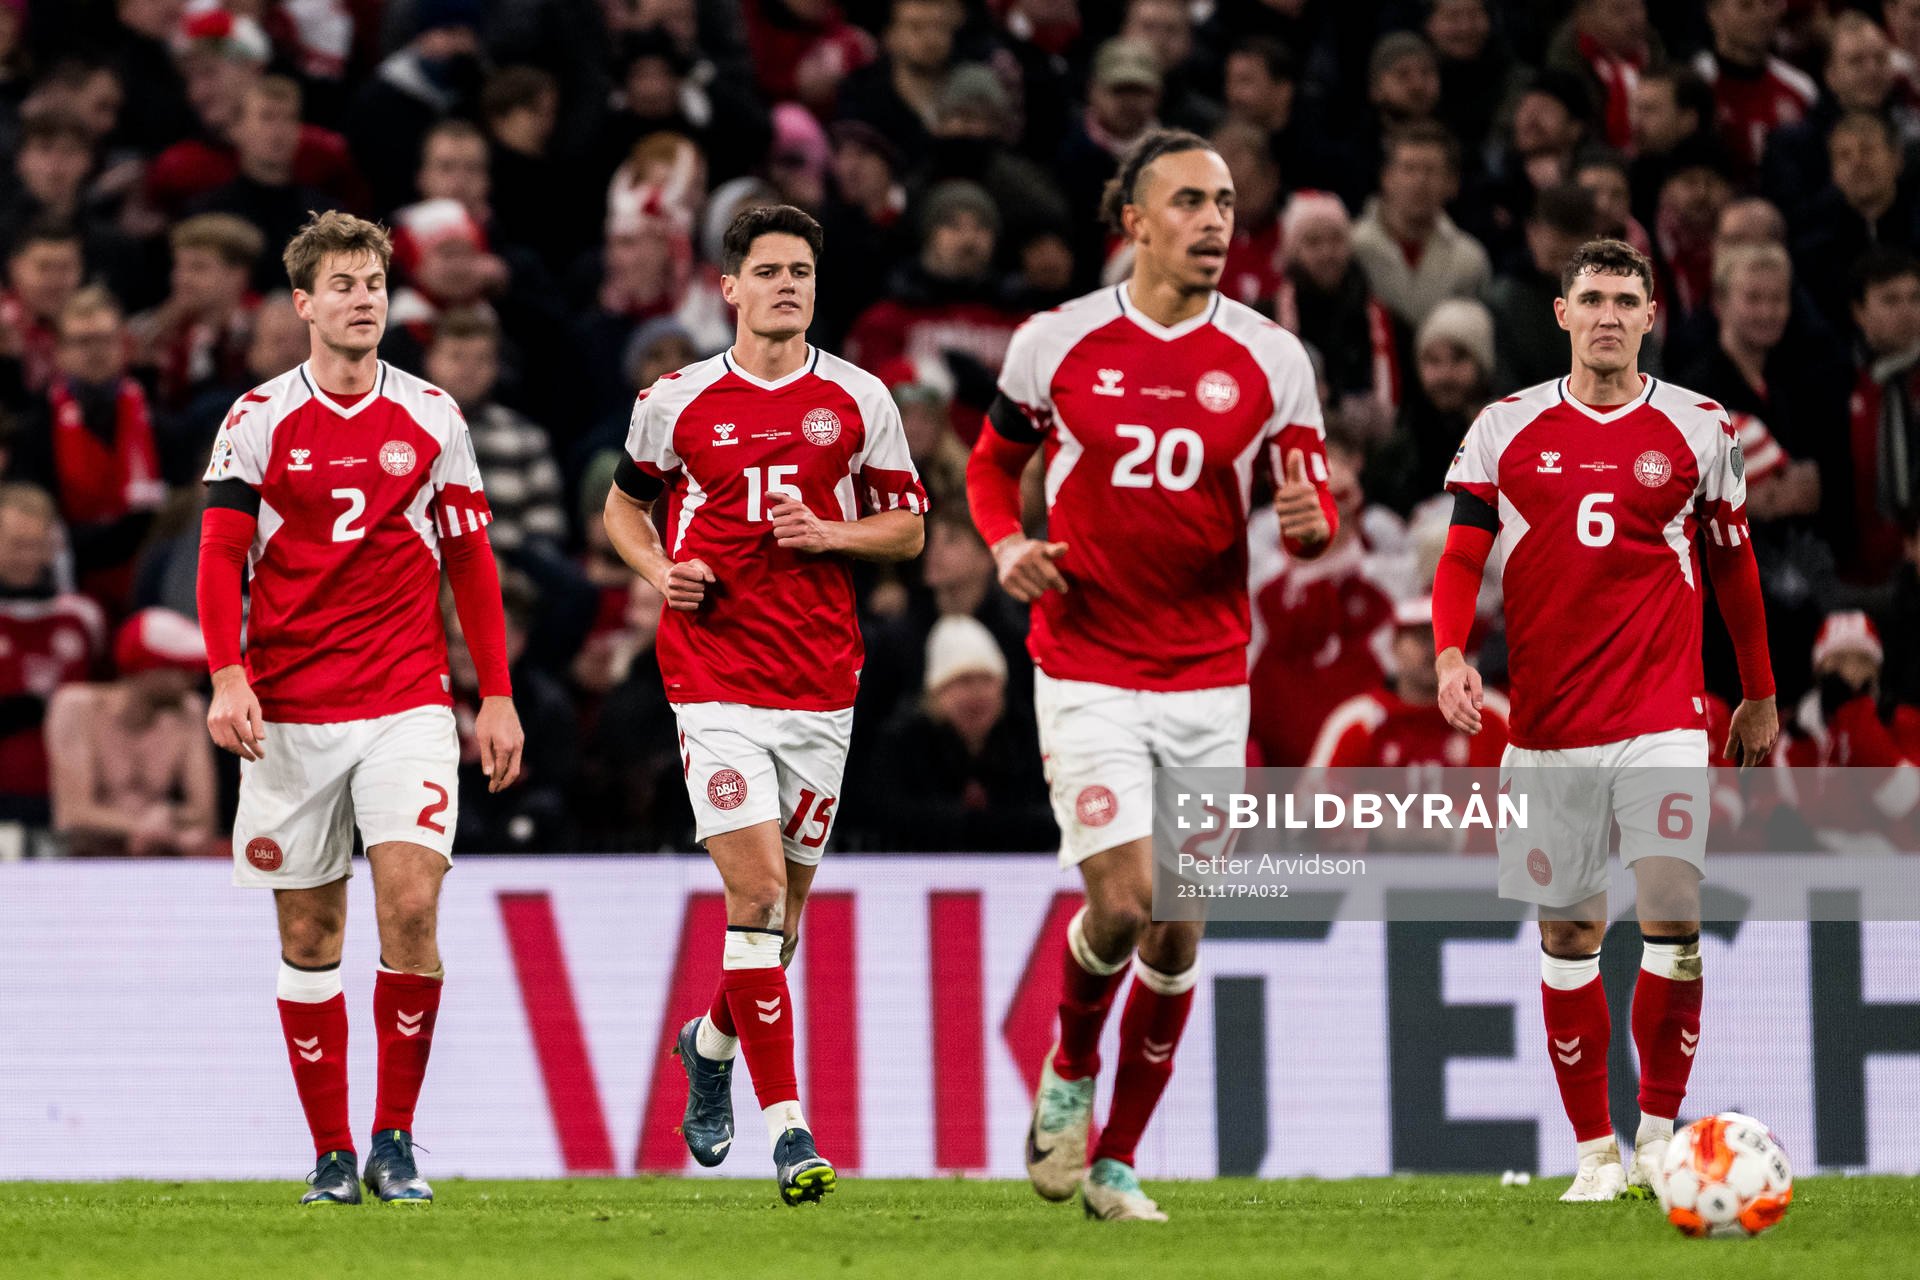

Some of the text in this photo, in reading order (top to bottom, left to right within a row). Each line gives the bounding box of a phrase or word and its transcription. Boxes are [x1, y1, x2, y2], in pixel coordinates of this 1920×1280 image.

[810, 421, 834, 432] DBU
[1111, 423, 1205, 491] 20
[1642, 462, 1664, 474] DBU
[331, 488, 366, 542] 2
[743, 465, 803, 522] 15
[1576, 493, 1615, 547] 6
[416, 780, 449, 836] 2
[715, 781, 739, 796] DBU
[783, 788, 837, 848] 15
[1657, 792, 1694, 840] 6
[255, 850, 274, 859] DBU
